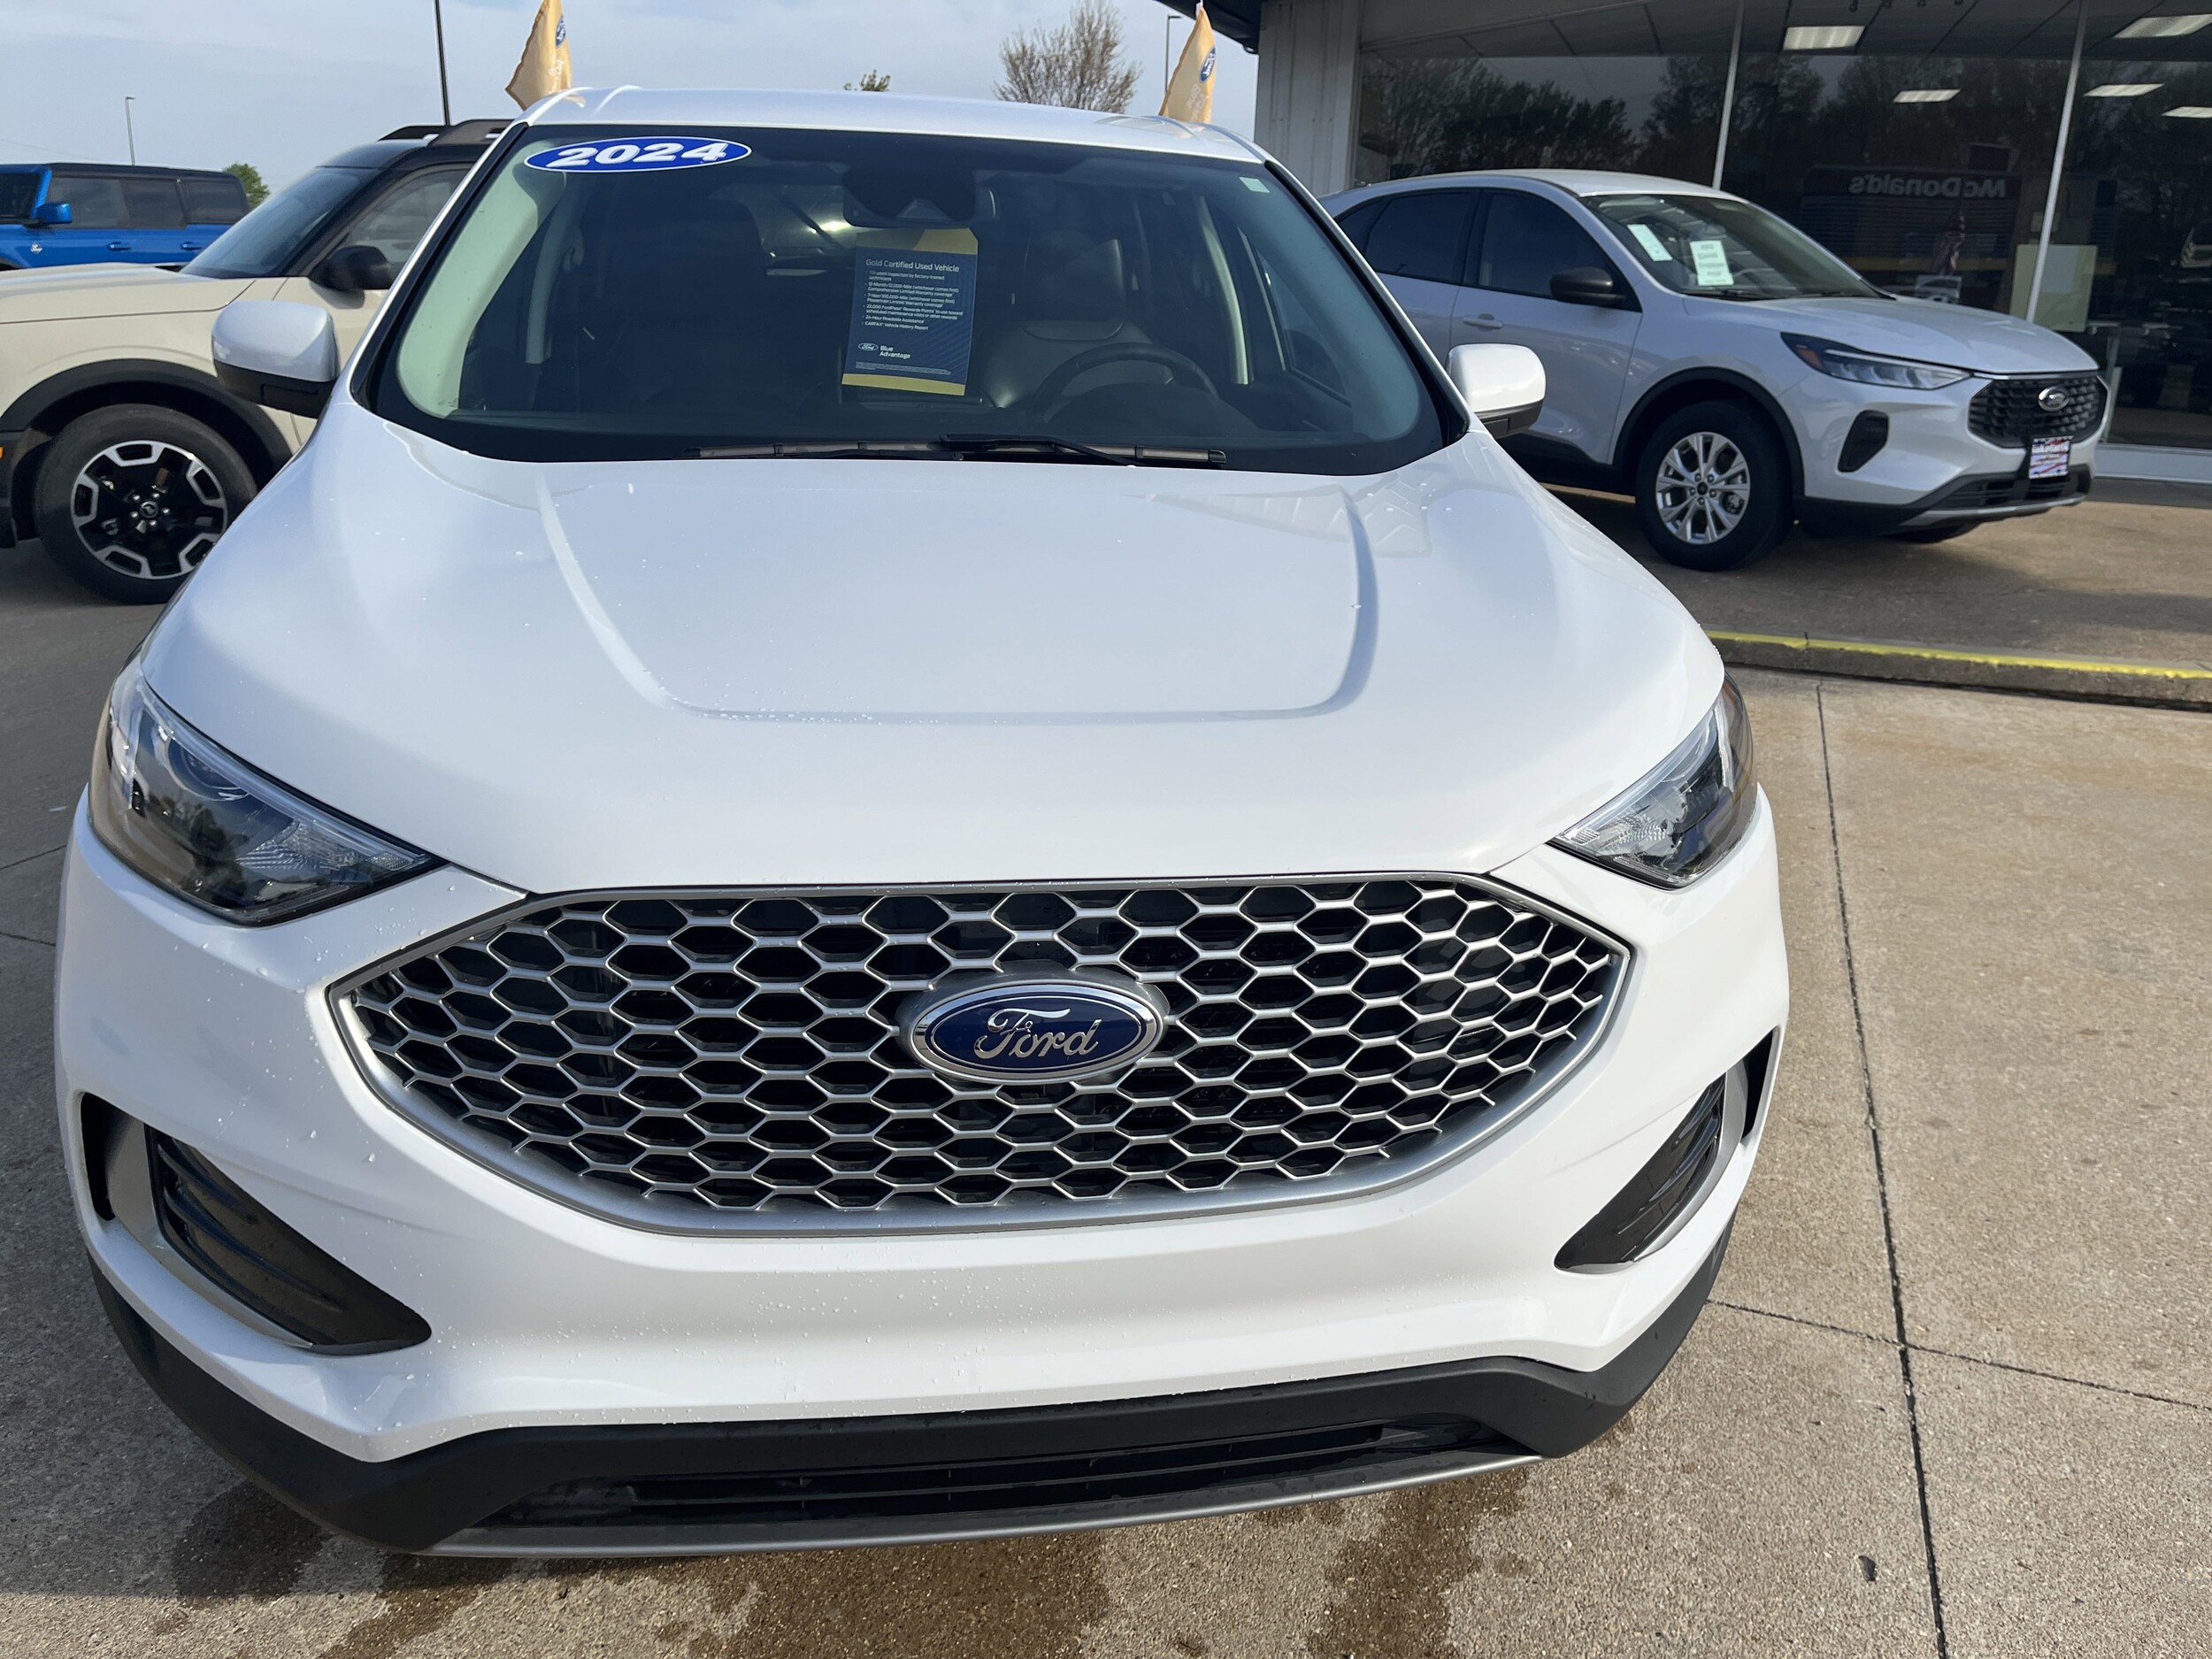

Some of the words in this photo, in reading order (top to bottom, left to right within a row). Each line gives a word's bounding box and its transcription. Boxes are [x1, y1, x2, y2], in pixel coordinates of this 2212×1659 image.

[546, 142, 728, 167] 2024
[884, 260, 914, 269] Certified
[934, 264, 960, 273] Vehicle
[974, 1008, 1102, 1059] Ford
